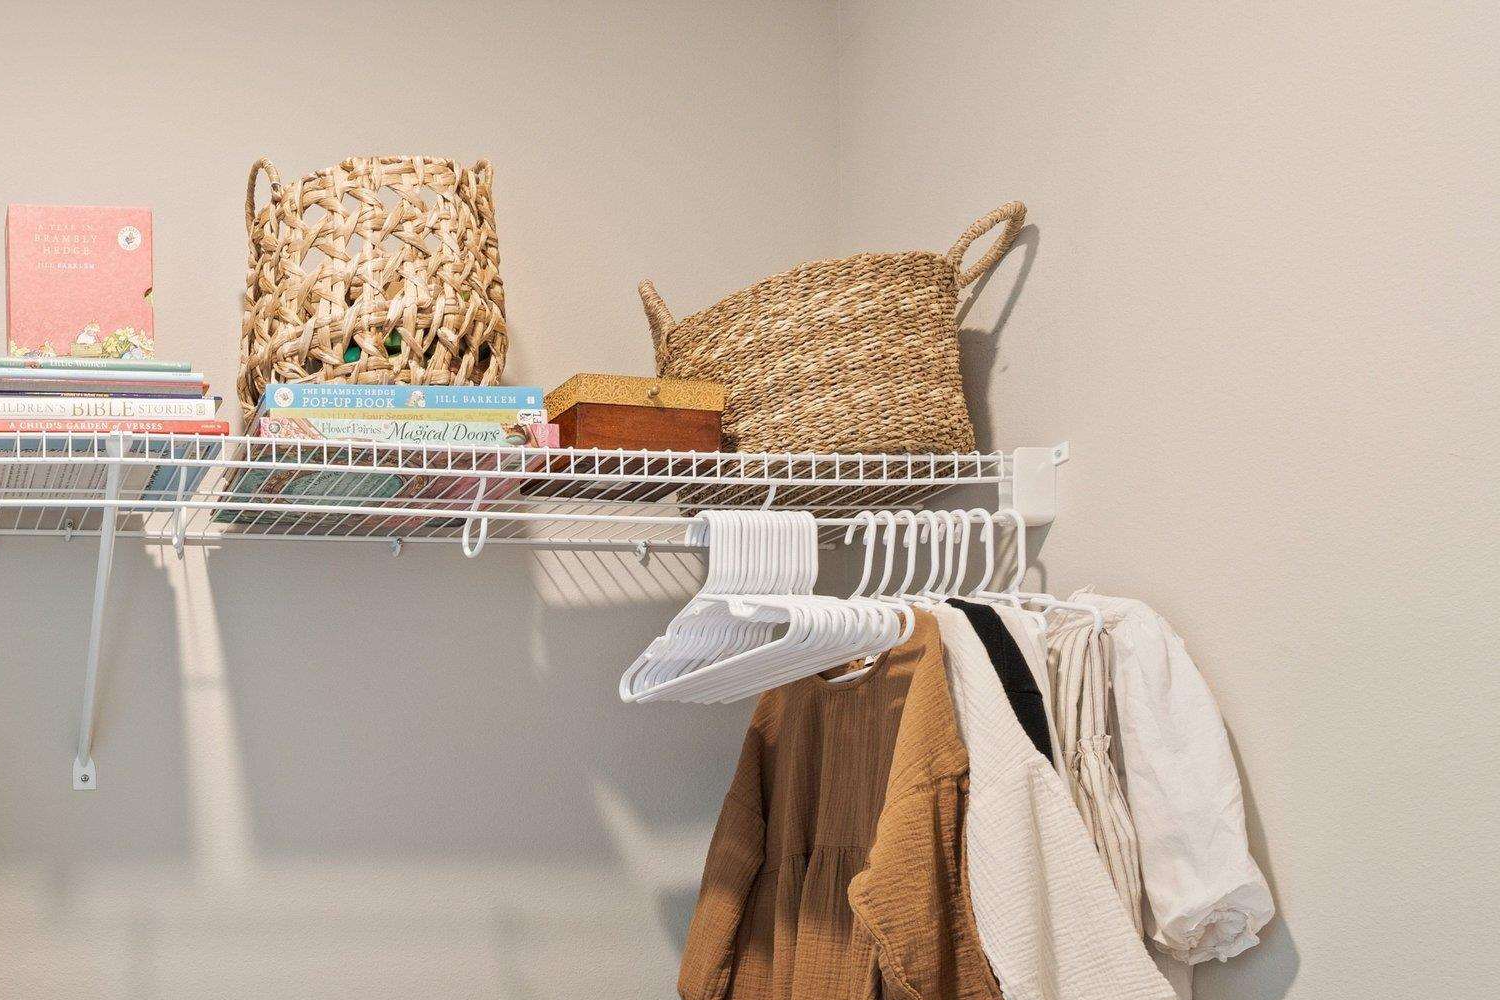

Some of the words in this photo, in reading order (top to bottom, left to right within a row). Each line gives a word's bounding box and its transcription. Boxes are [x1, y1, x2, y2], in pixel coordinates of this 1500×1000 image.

[50, 359, 74, 368] Little
[75, 360, 107, 369] Women
[321, 388, 362, 396] BRAMBLY
[302, 398, 352, 408] POP-UP
[356, 398, 395, 408] BOOK
[435, 395, 458, 404] JILL
[463, 396, 517, 404] BARKLEM
[71, 402, 135, 417] BIBLE
[138, 404, 193, 414] STORIES
[67, 422, 108, 430] GARDEN
[126, 422, 164, 430] VERSES
[387, 420, 450, 444] Magical
[452, 422, 500, 442] Doors
